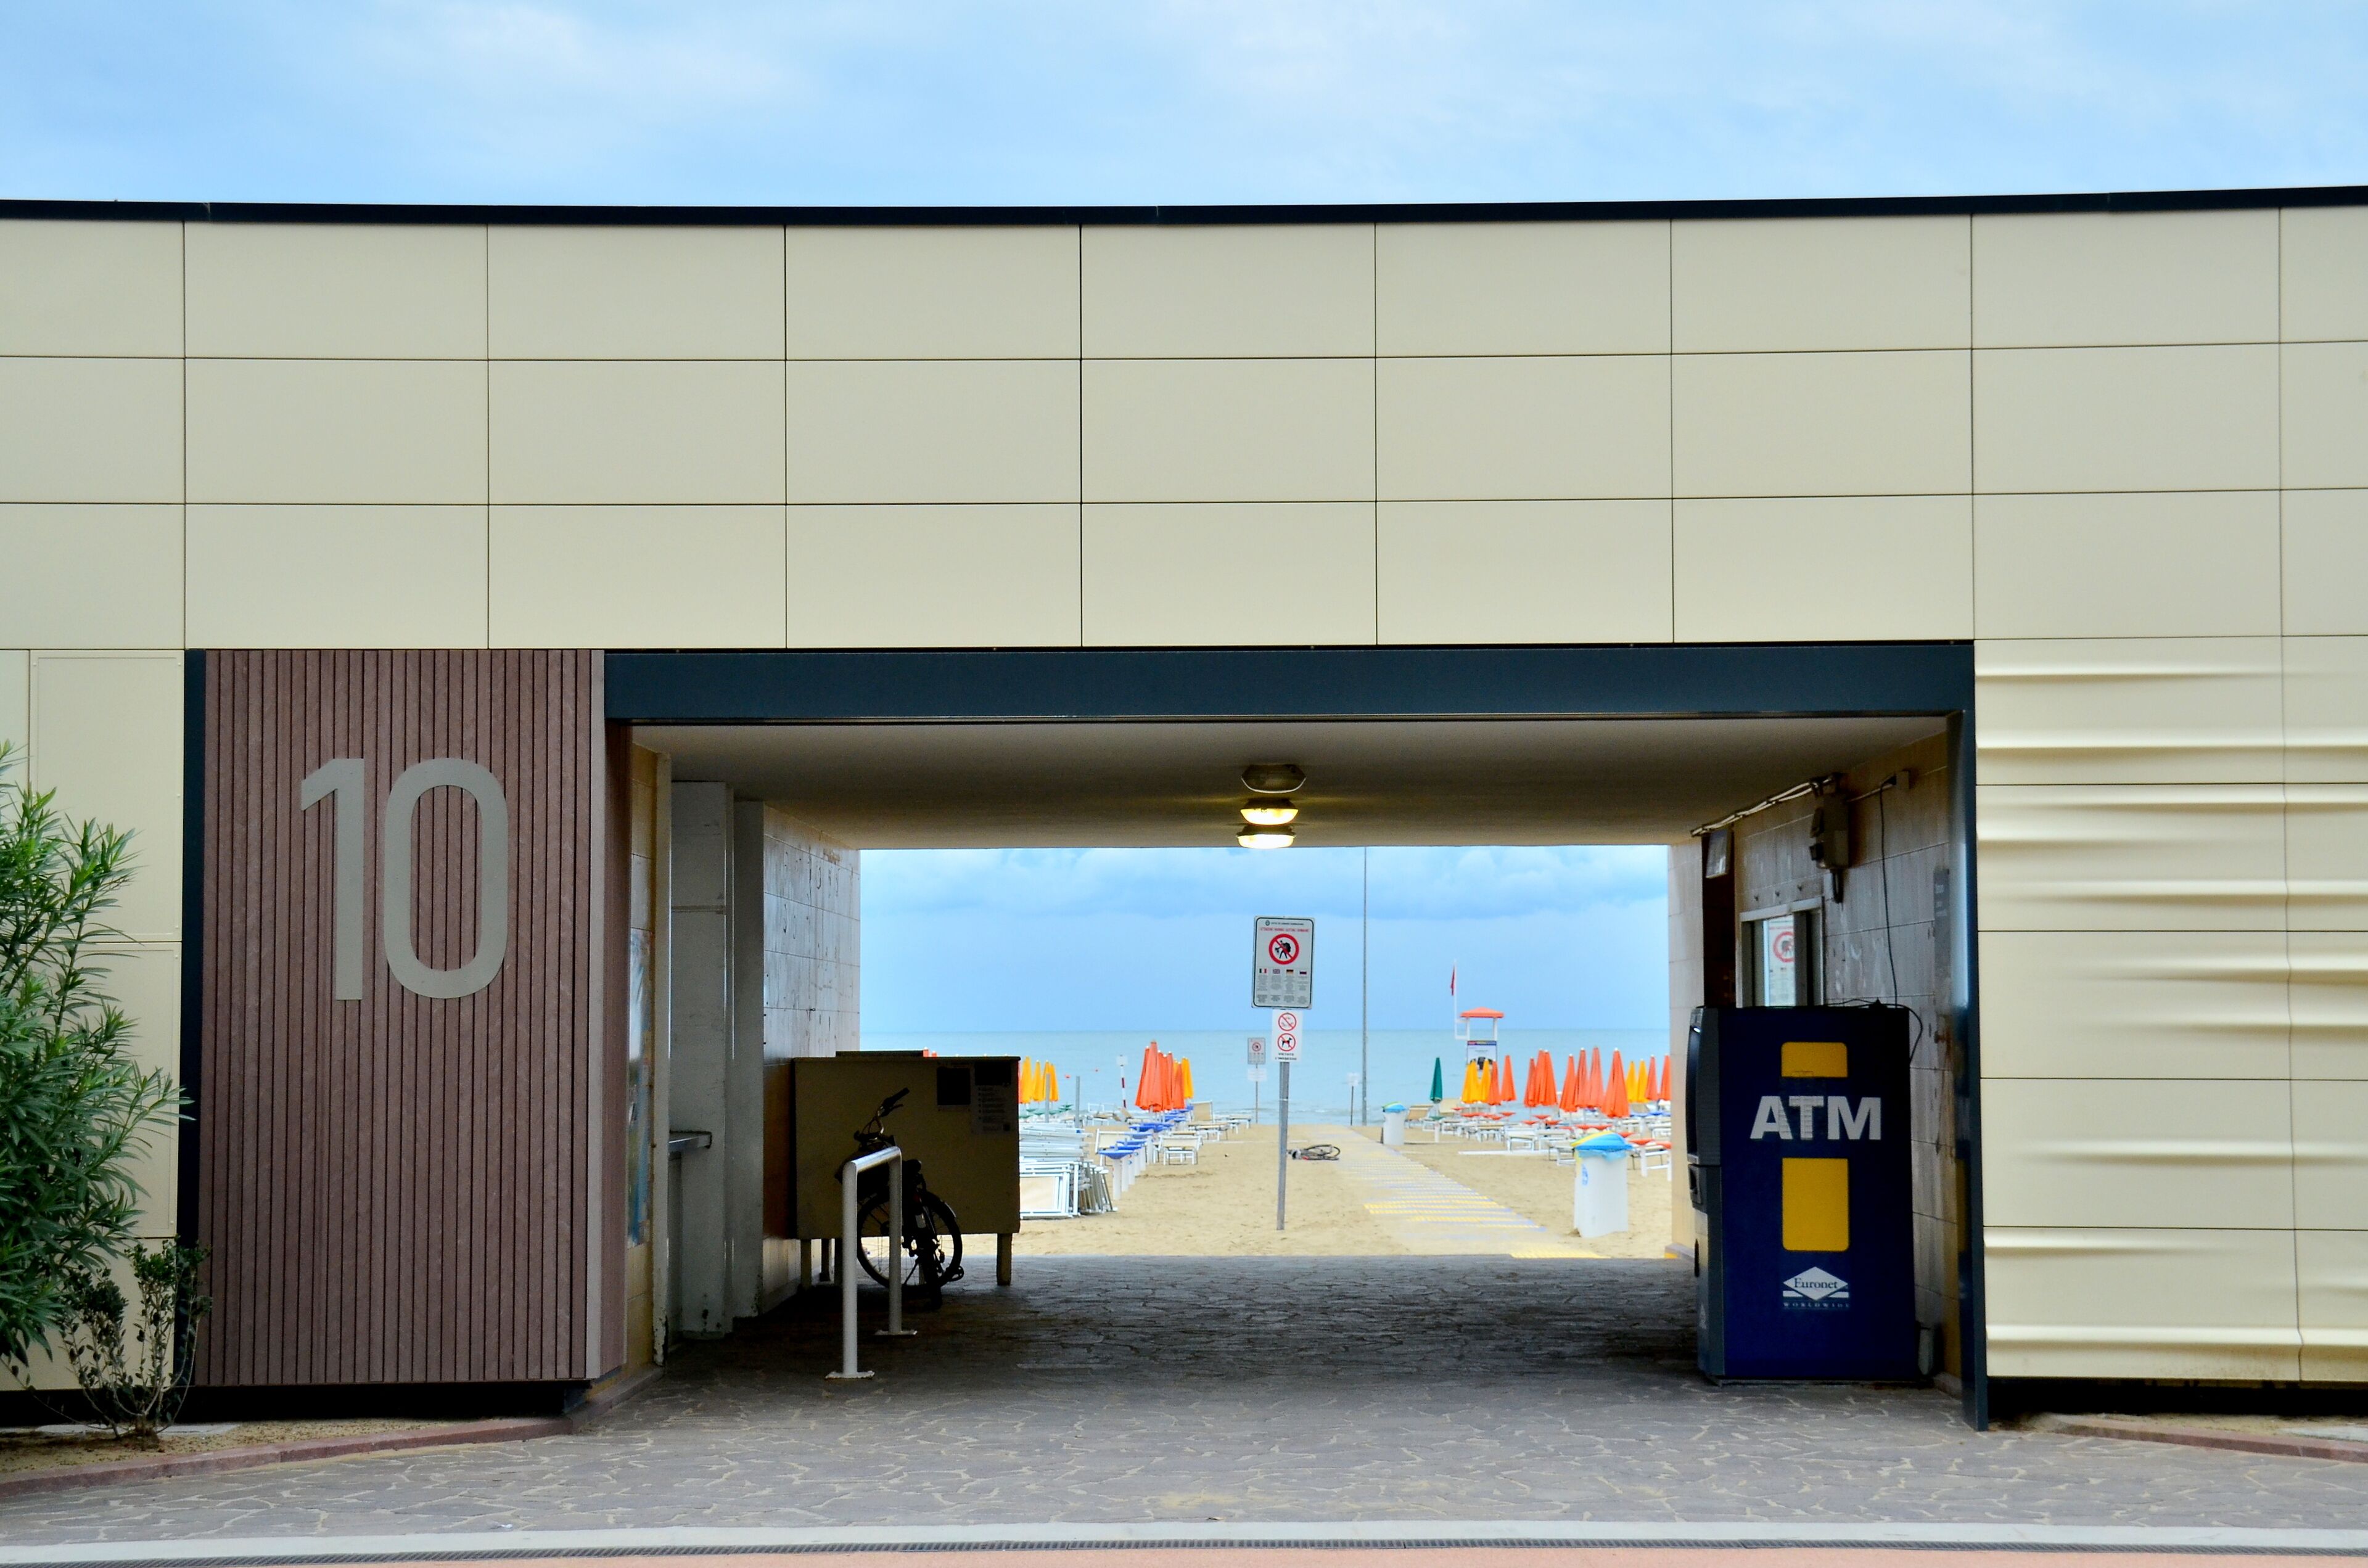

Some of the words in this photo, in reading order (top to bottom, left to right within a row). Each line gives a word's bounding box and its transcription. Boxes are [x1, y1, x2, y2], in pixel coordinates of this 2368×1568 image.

[300, 757, 509, 1001] 10
[1749, 1095, 1881, 1140] ATM
[1793, 1278, 1838, 1289] Euronet
